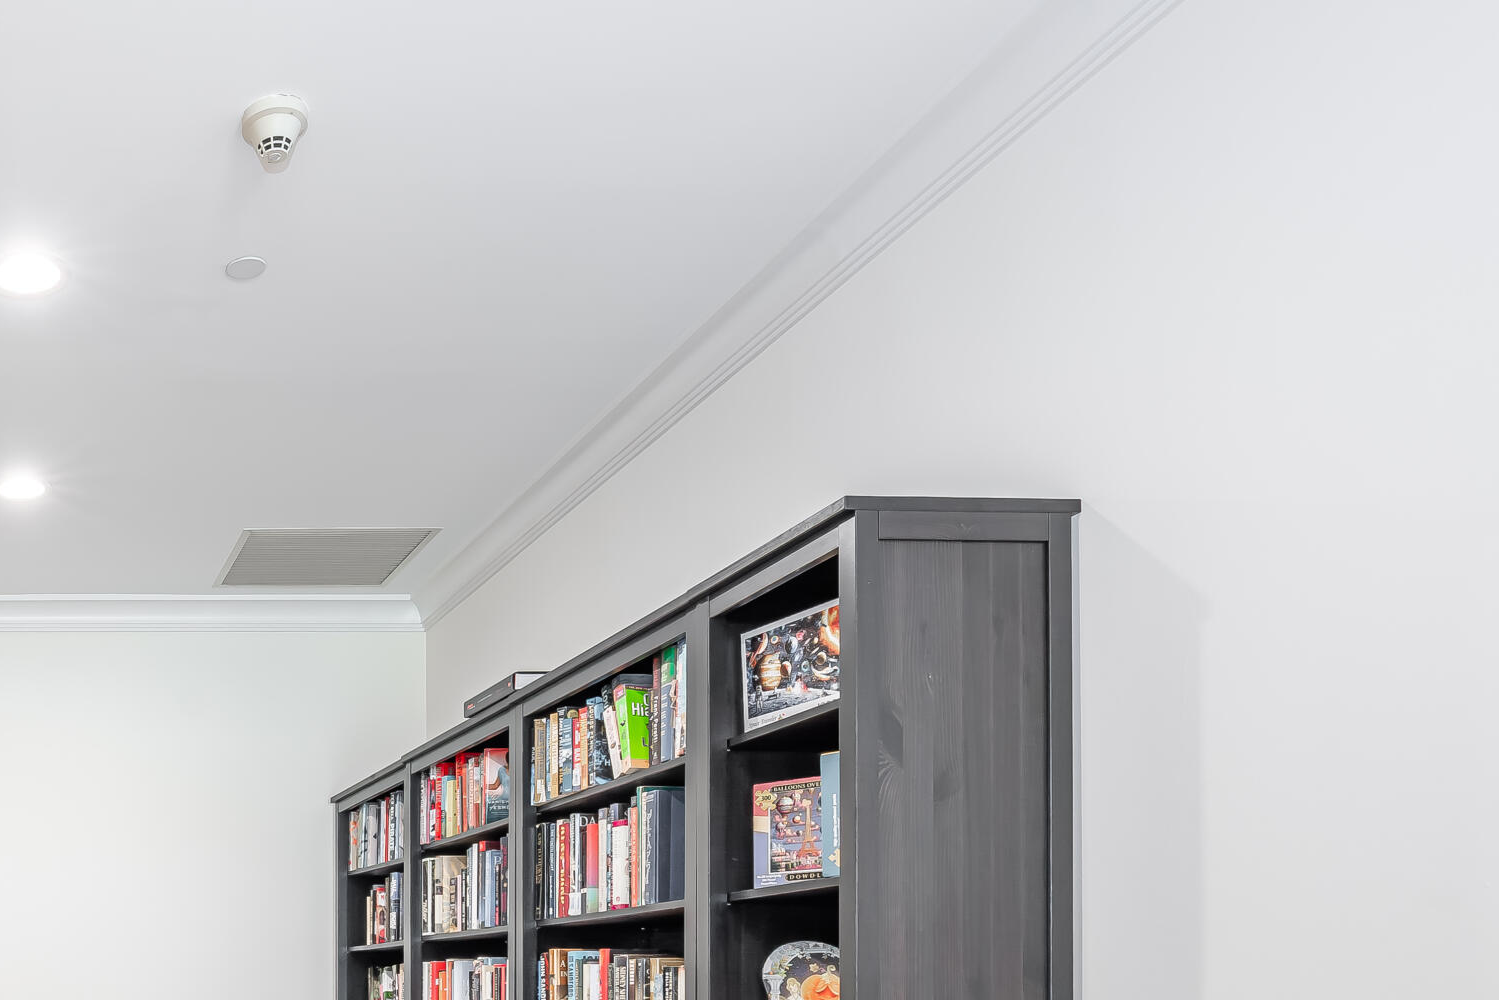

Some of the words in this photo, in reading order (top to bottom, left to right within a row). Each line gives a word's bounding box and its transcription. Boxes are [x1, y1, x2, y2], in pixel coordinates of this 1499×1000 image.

[631, 702, 650, 717] Hia
[580, 816, 597, 827] DA
[789, 872, 821, 880] DOWDL
[619, 966, 627, 988] SIDNEY
